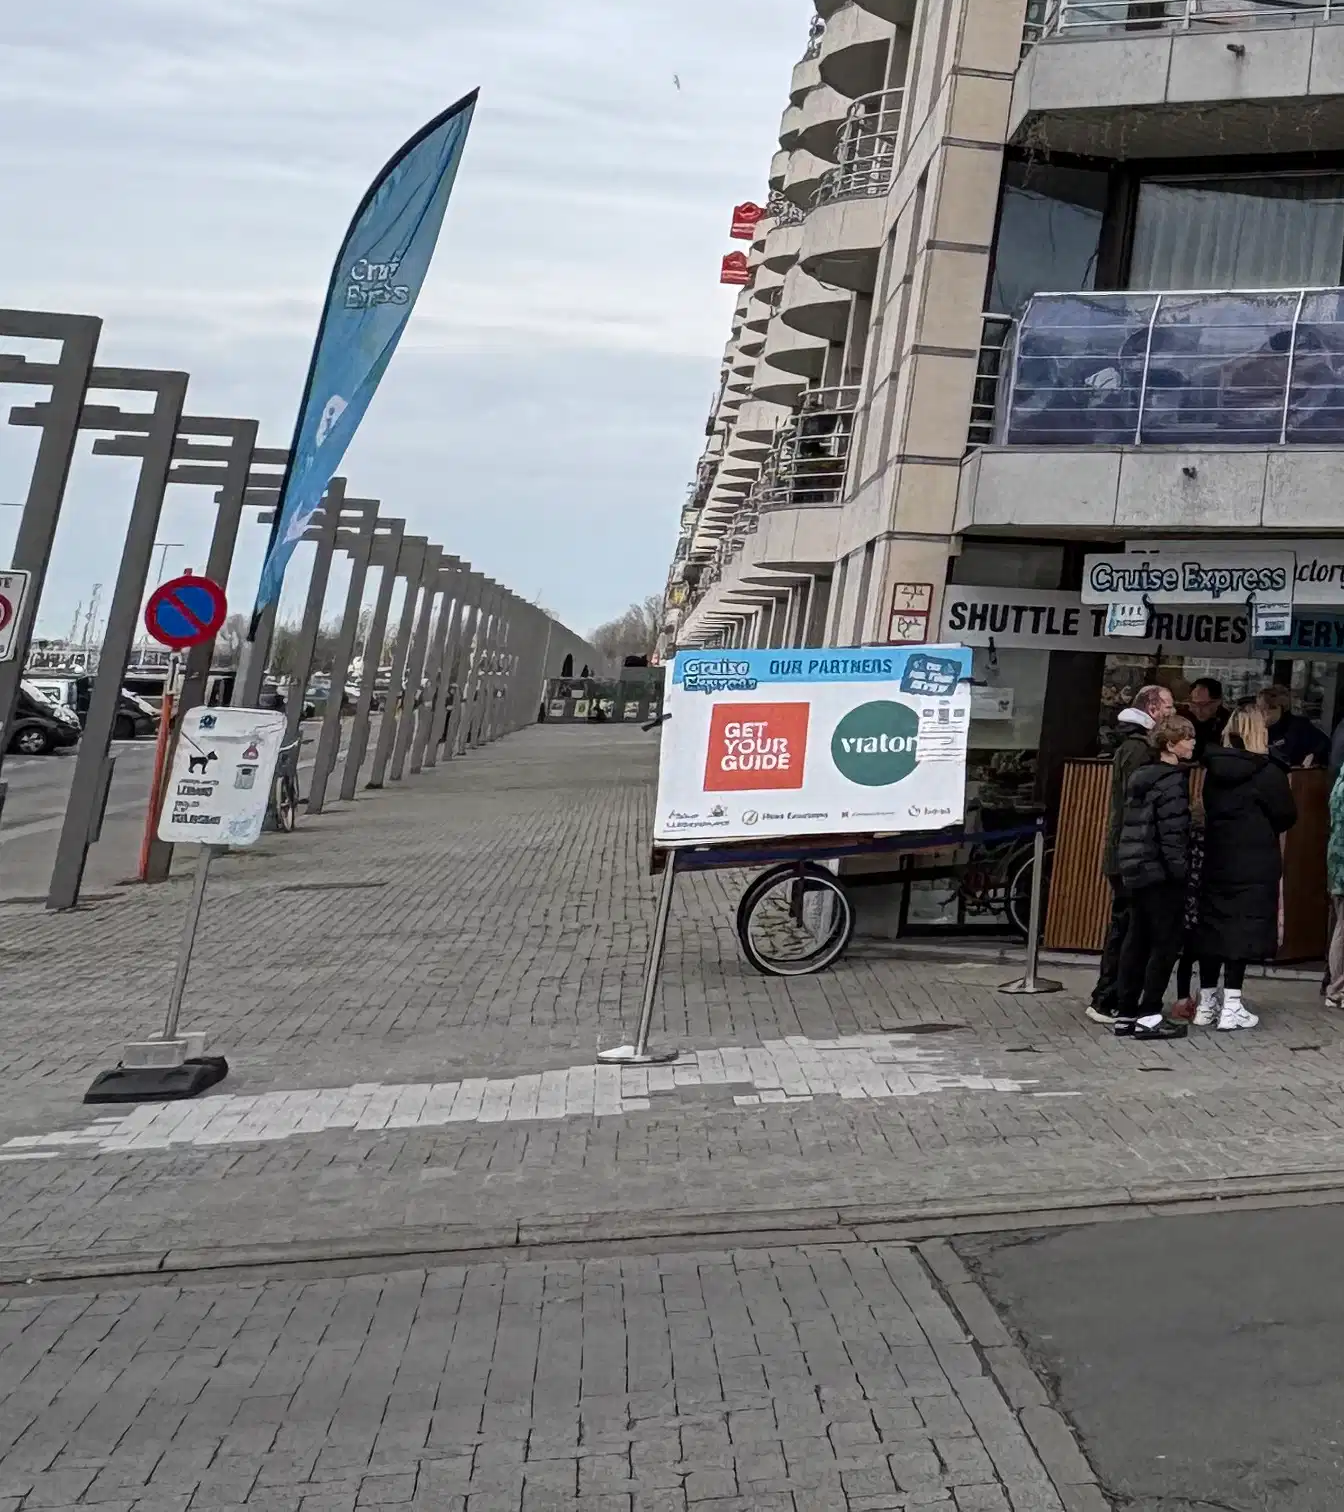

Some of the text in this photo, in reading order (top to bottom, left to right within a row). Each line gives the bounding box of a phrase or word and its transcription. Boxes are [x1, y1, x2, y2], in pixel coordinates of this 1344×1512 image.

[1090, 561, 1287, 598] Cruise Express
[949, 601, 1080, 637] SHUTTLE
[769, 658, 893, 675] OUR PARTNERS
[724, 721, 768, 738] GET
[723, 737, 789, 755] YOUR
[720, 753, 791, 771] GUIDE
